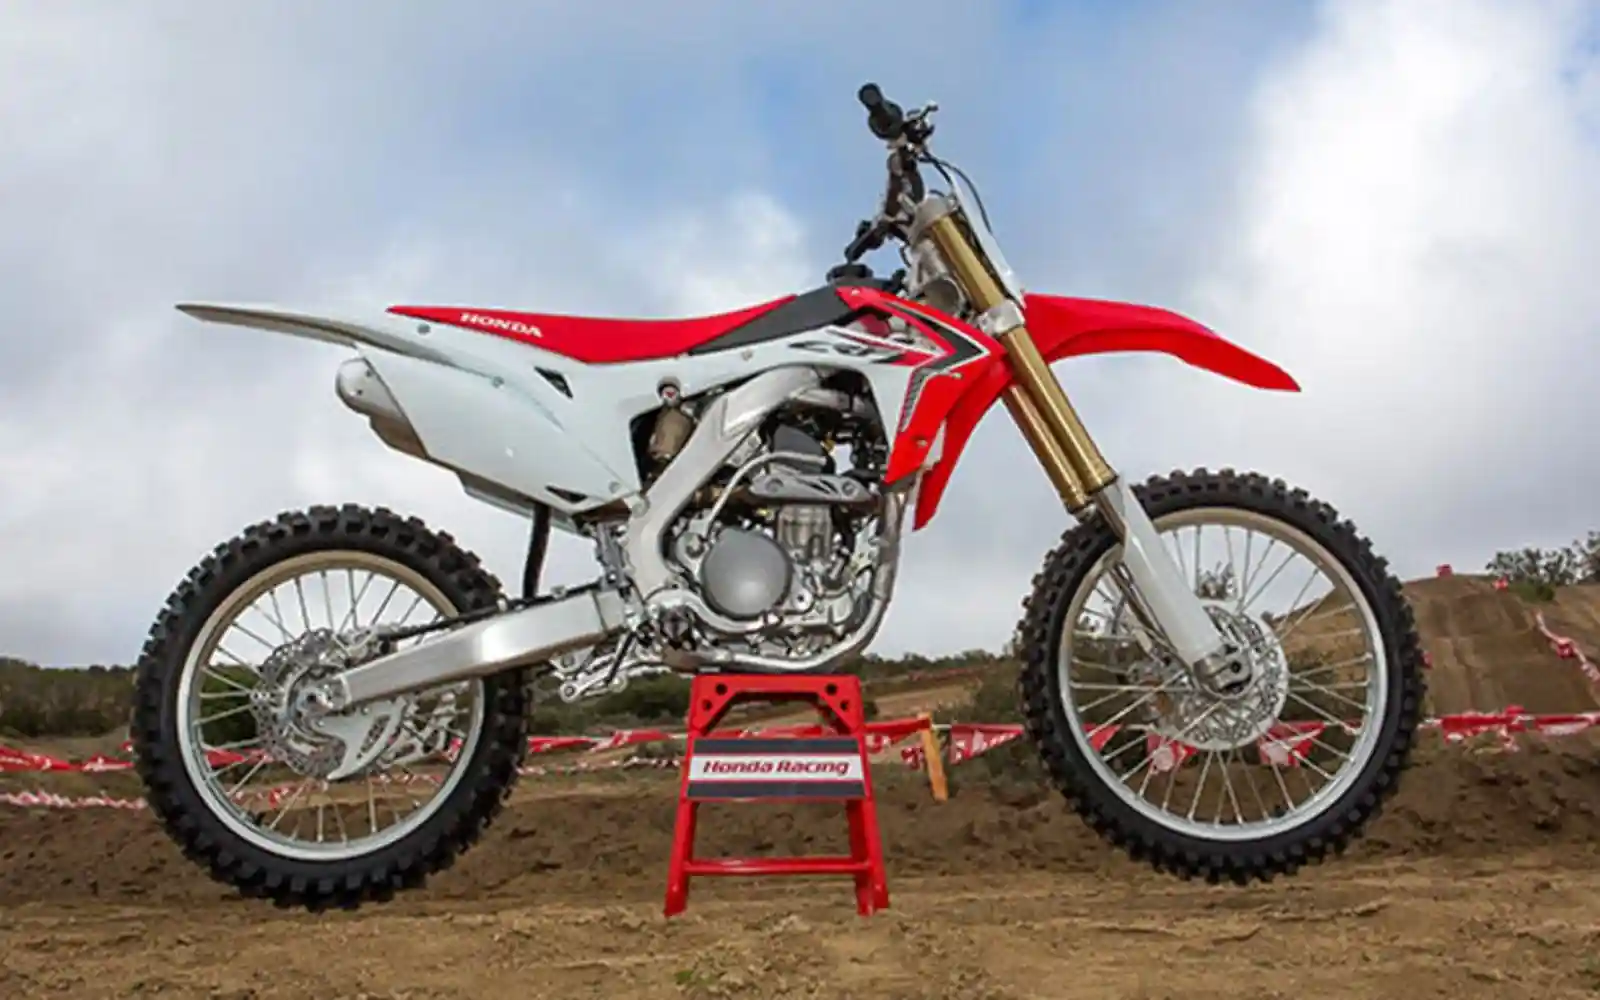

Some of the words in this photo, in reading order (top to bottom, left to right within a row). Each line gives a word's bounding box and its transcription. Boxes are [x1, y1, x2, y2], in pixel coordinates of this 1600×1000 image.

[460, 312, 543, 338] HONDA
[703, 760, 774, 774] Honda
[776, 760, 849, 776] Racing
